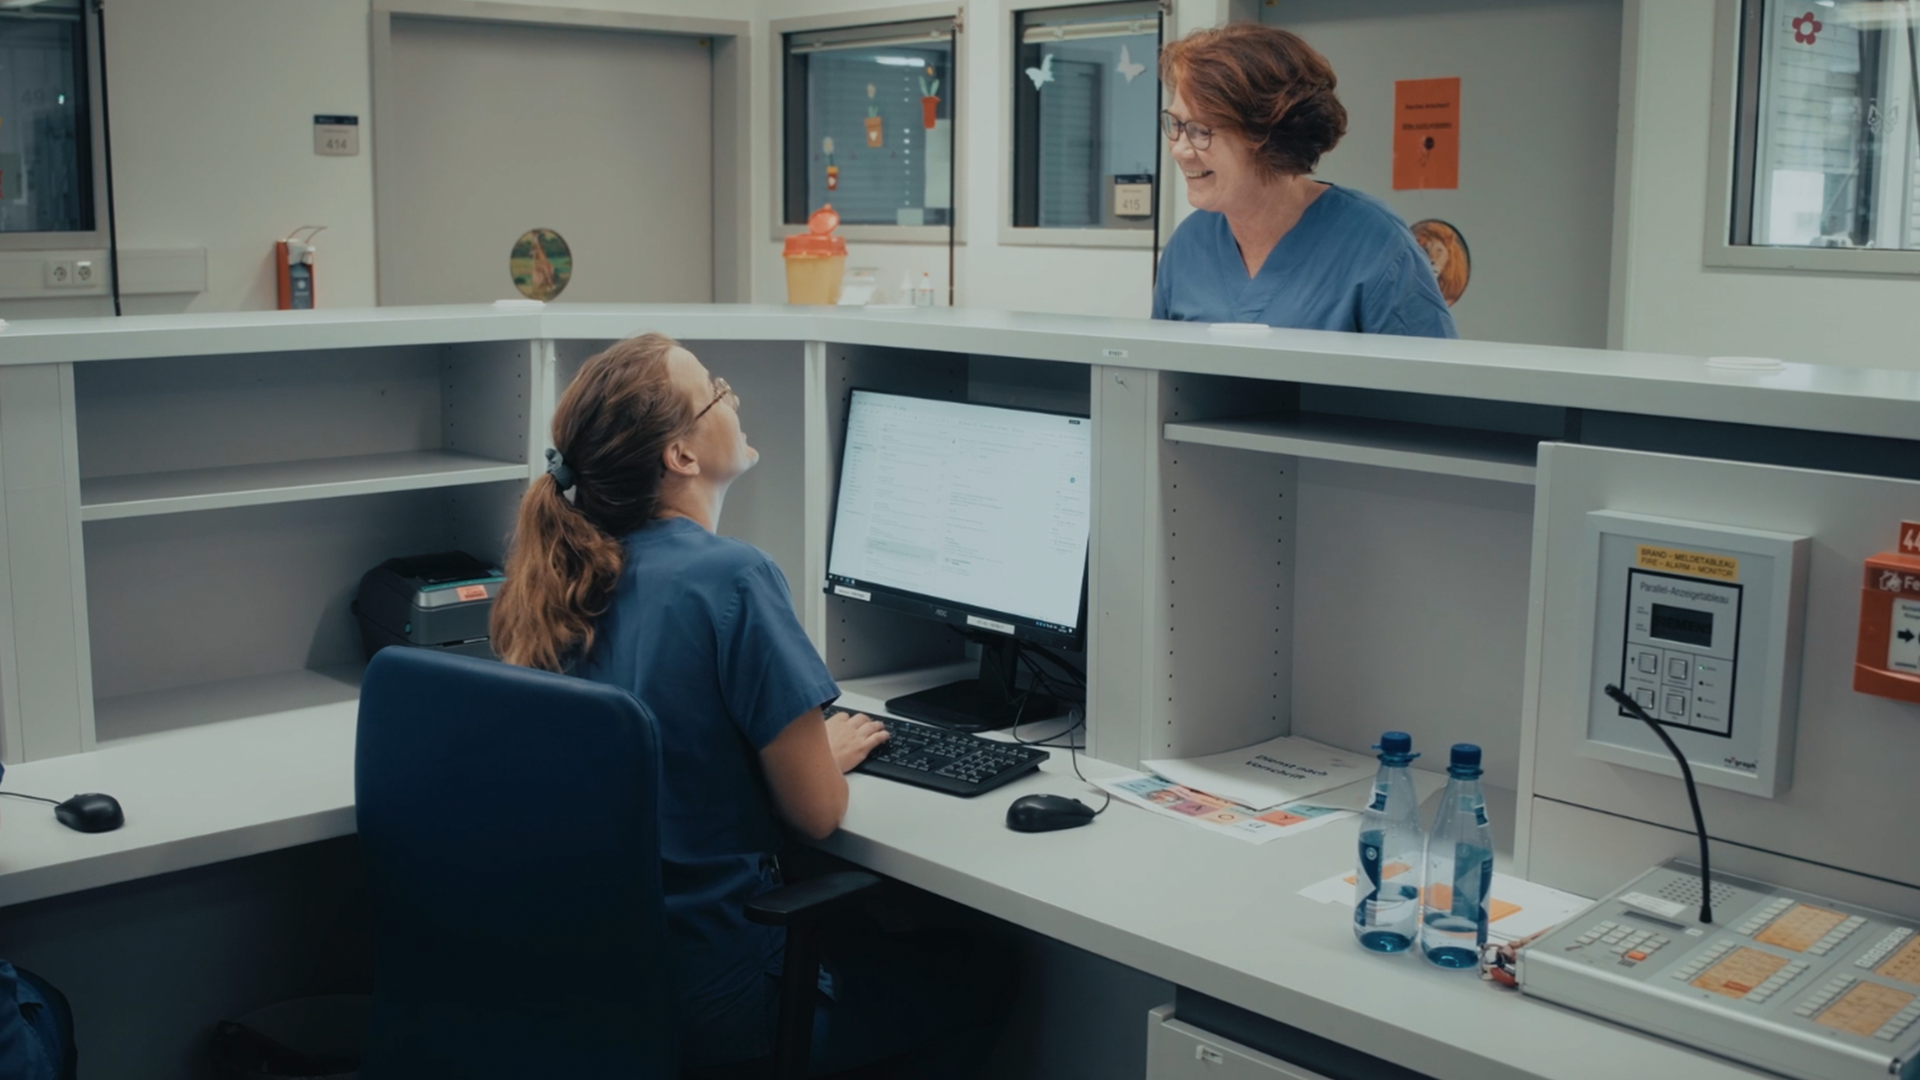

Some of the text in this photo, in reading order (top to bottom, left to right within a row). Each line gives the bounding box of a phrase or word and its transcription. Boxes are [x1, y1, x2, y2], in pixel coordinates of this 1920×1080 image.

[326, 139, 347, 150] 414
[1122, 199, 1140, 211] 415
[1641, 548, 1668, 560] BRAND
[1674, 553, 1735, 569] MELDETABLEAU
[1641, 557, 1658, 567] FIRE
[1665, 561, 1691, 571] ALARM
[1697, 566, 1734, 577] MONITOR
[1640, 581, 1729, 604] Parallel-Anzeigetableau
[1246, 760, 1306, 780] Vorschrift
[1255, 754, 1328, 777] Dienst nach
